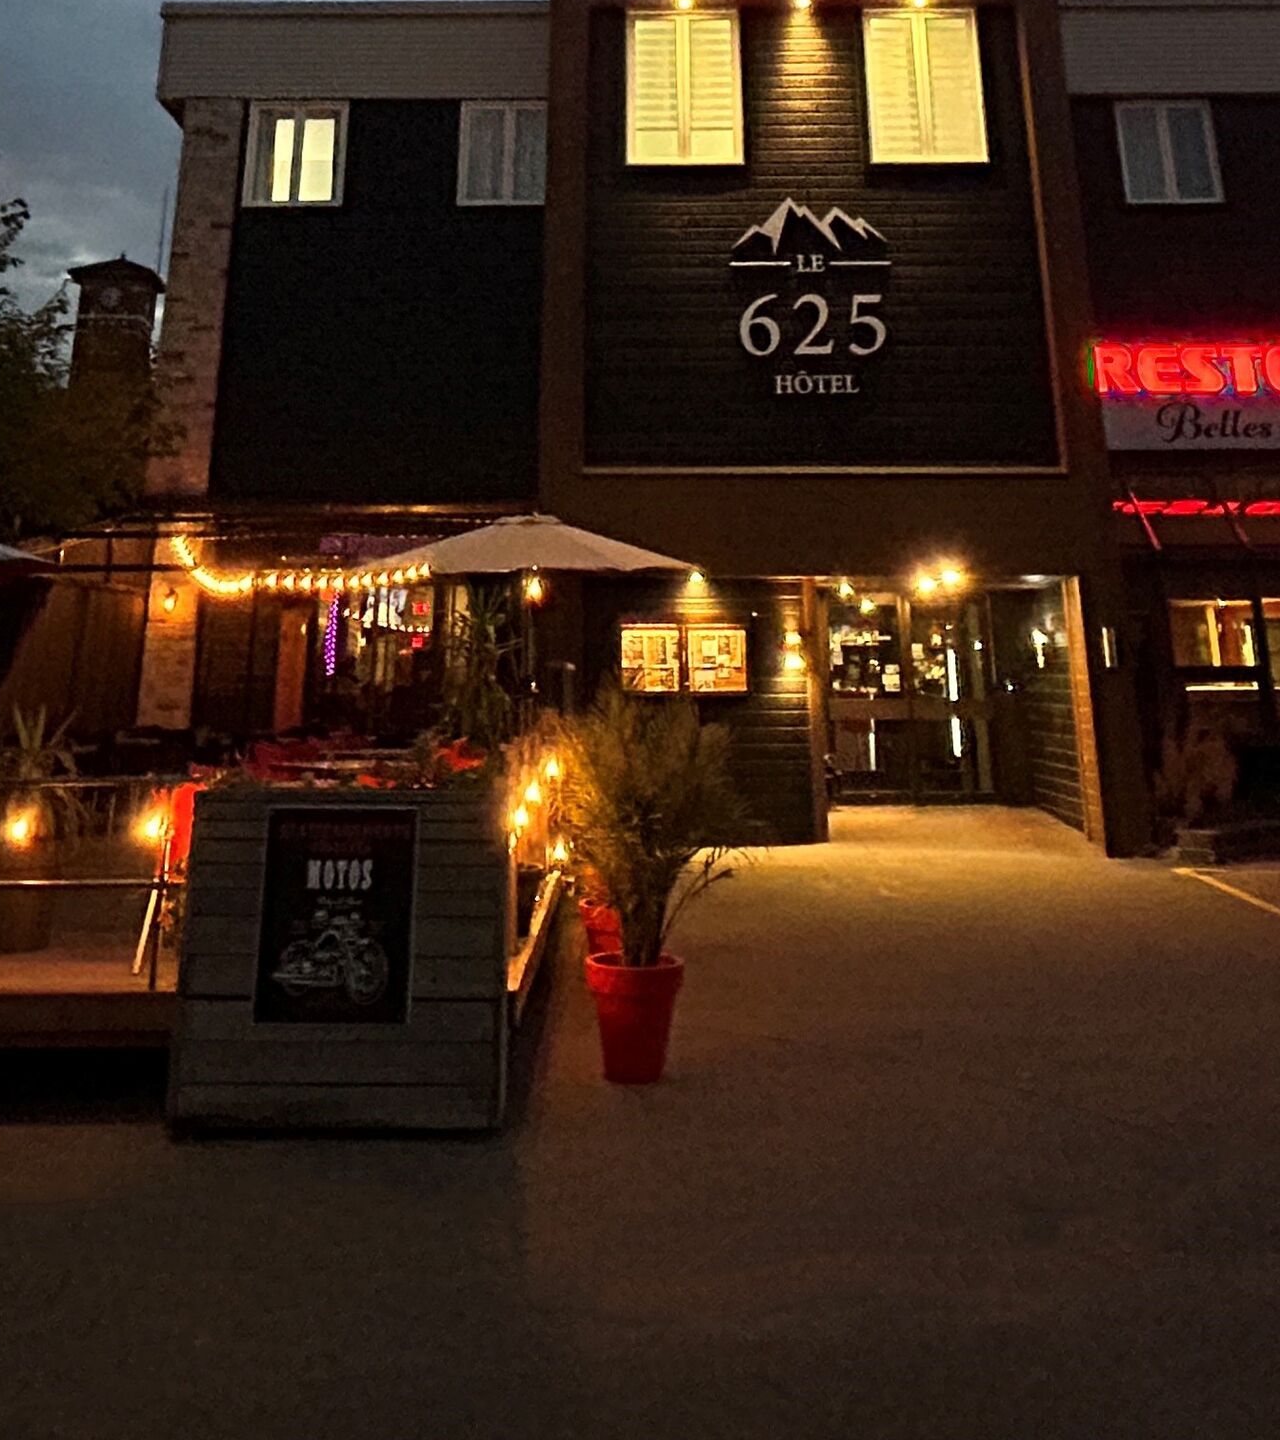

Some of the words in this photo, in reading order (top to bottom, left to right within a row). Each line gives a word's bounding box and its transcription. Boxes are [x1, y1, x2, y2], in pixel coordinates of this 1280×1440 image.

[795, 253, 826, 273] LE
[739, 293, 887, 357] 625
[775, 368, 861, 394] HÔTEL
[1156, 402, 1273, 443] Belles
[306, 858, 373, 891] MOTOS
